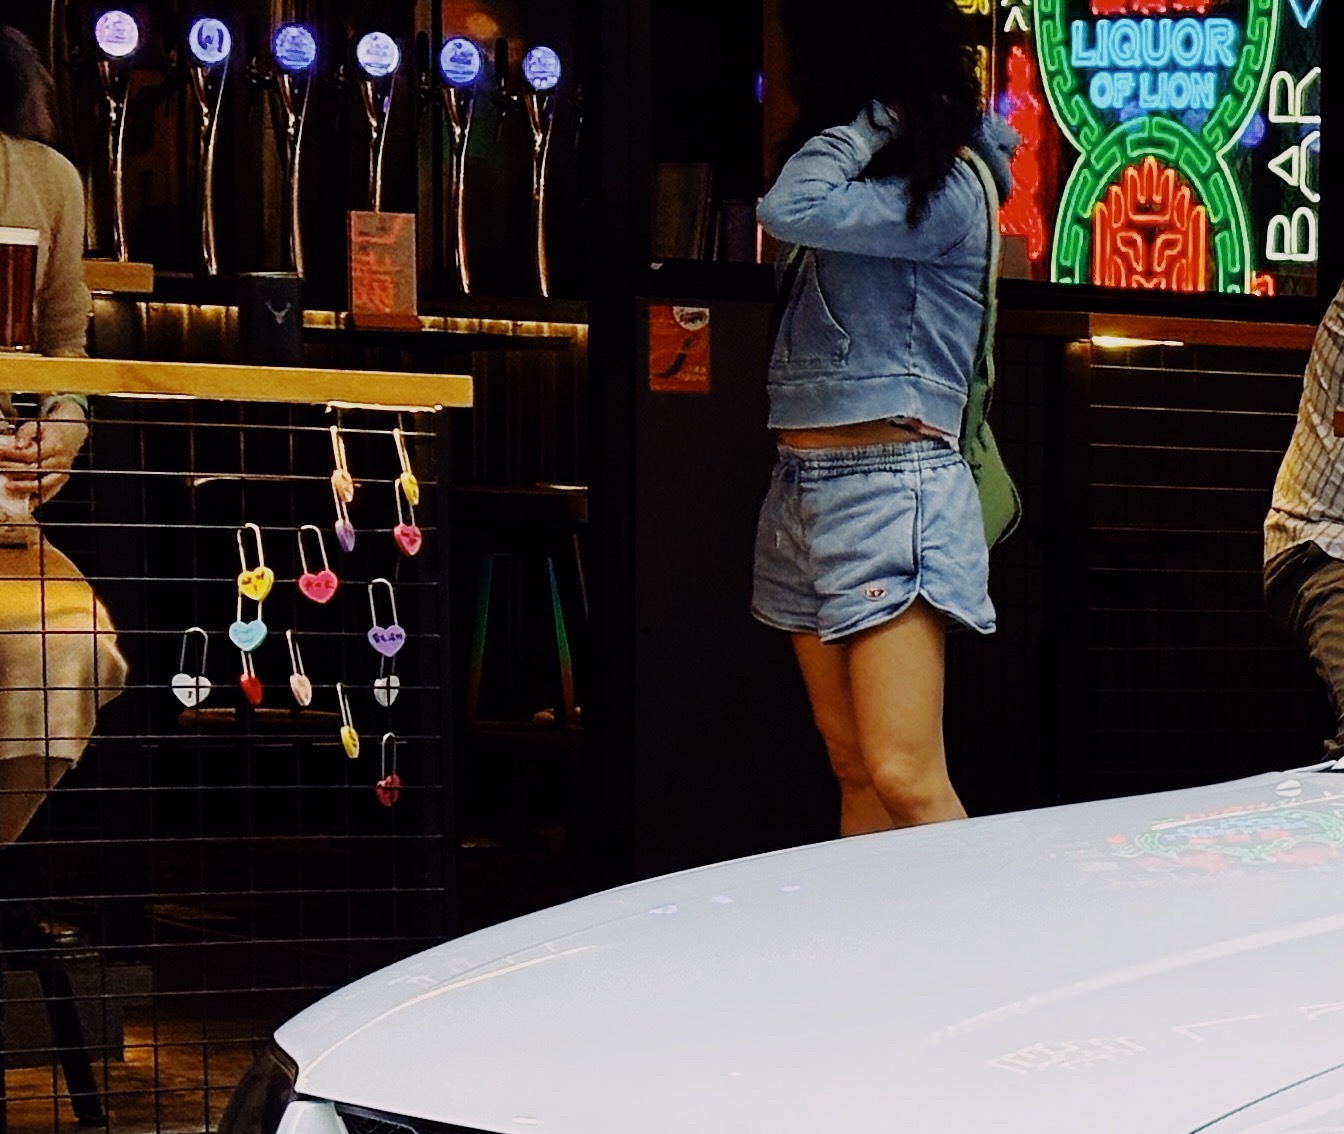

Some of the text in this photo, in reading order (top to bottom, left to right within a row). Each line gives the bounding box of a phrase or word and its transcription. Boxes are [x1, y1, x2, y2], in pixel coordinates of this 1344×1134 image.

[1071, 18, 1237, 67] LIQUOR
[1090, 72, 1216, 109] OF LION
[1266, 66, 1321, 262] BAR
